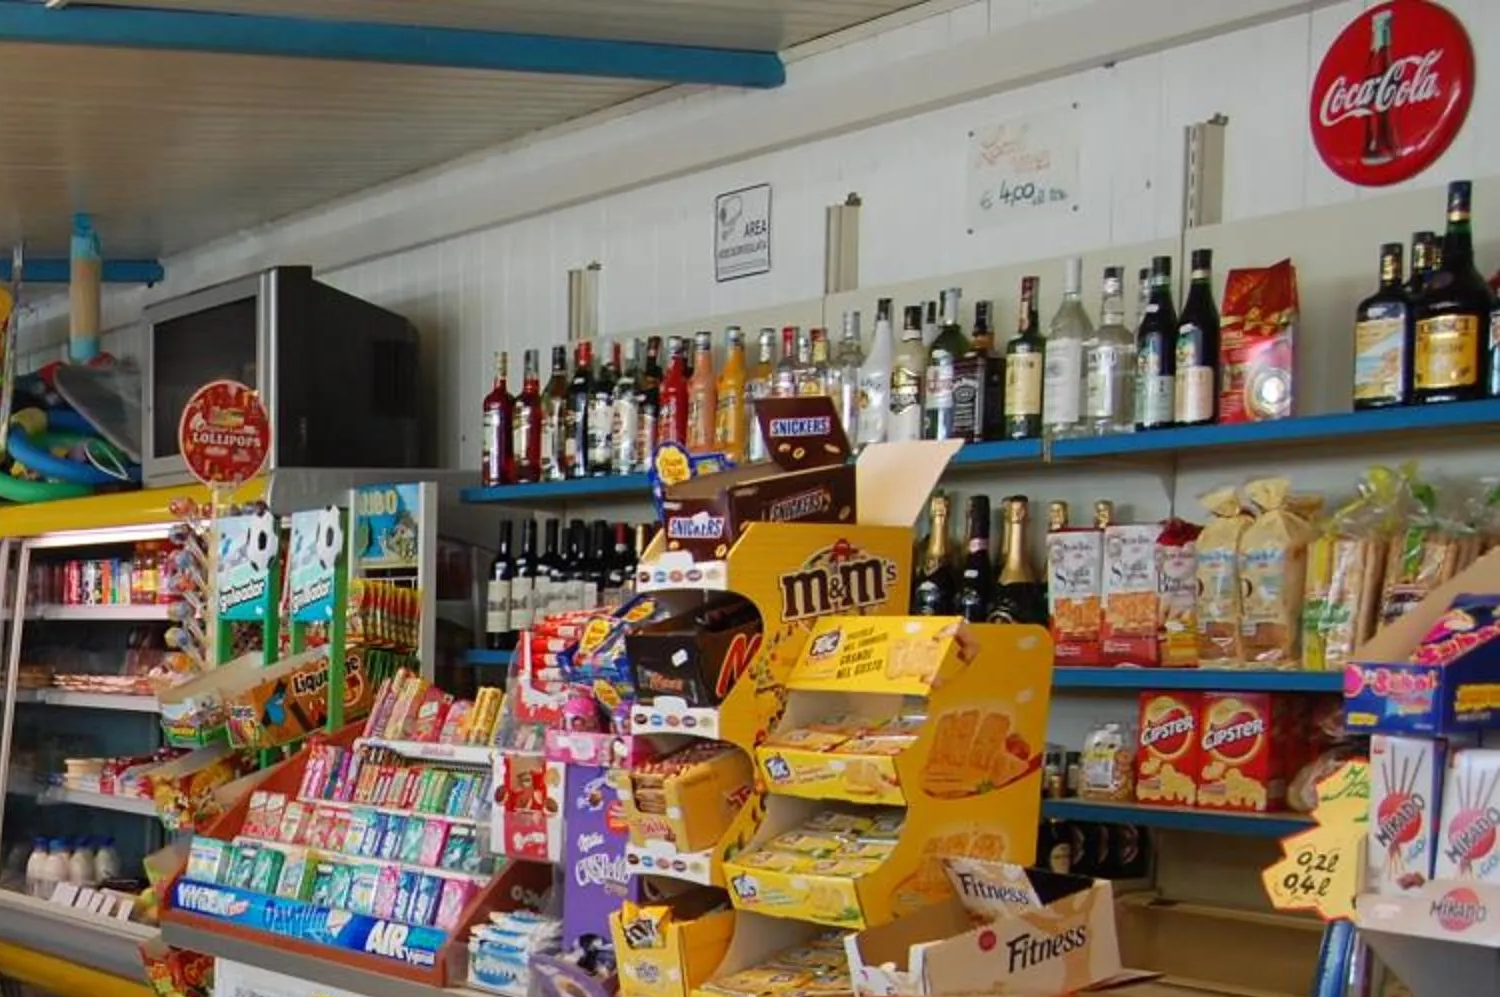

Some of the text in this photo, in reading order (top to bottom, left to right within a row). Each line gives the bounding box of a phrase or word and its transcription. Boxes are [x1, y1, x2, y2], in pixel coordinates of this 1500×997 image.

[1319, 48, 1444, 127] Coca-Cola
[744, 219, 767, 238] AREA
[193, 431, 261, 448] LOLLIPOPS
[770, 416, 830, 437] SNICKERS
[1374, 793, 1425, 848] MIKADO
[1445, 807, 1500, 864] MIKADO
[958, 873, 1030, 905] Fitness
[1429, 900, 1487, 922] MIKADO
[365, 920, 408, 958] AIR
[1006, 925, 1087, 974] Fitness
